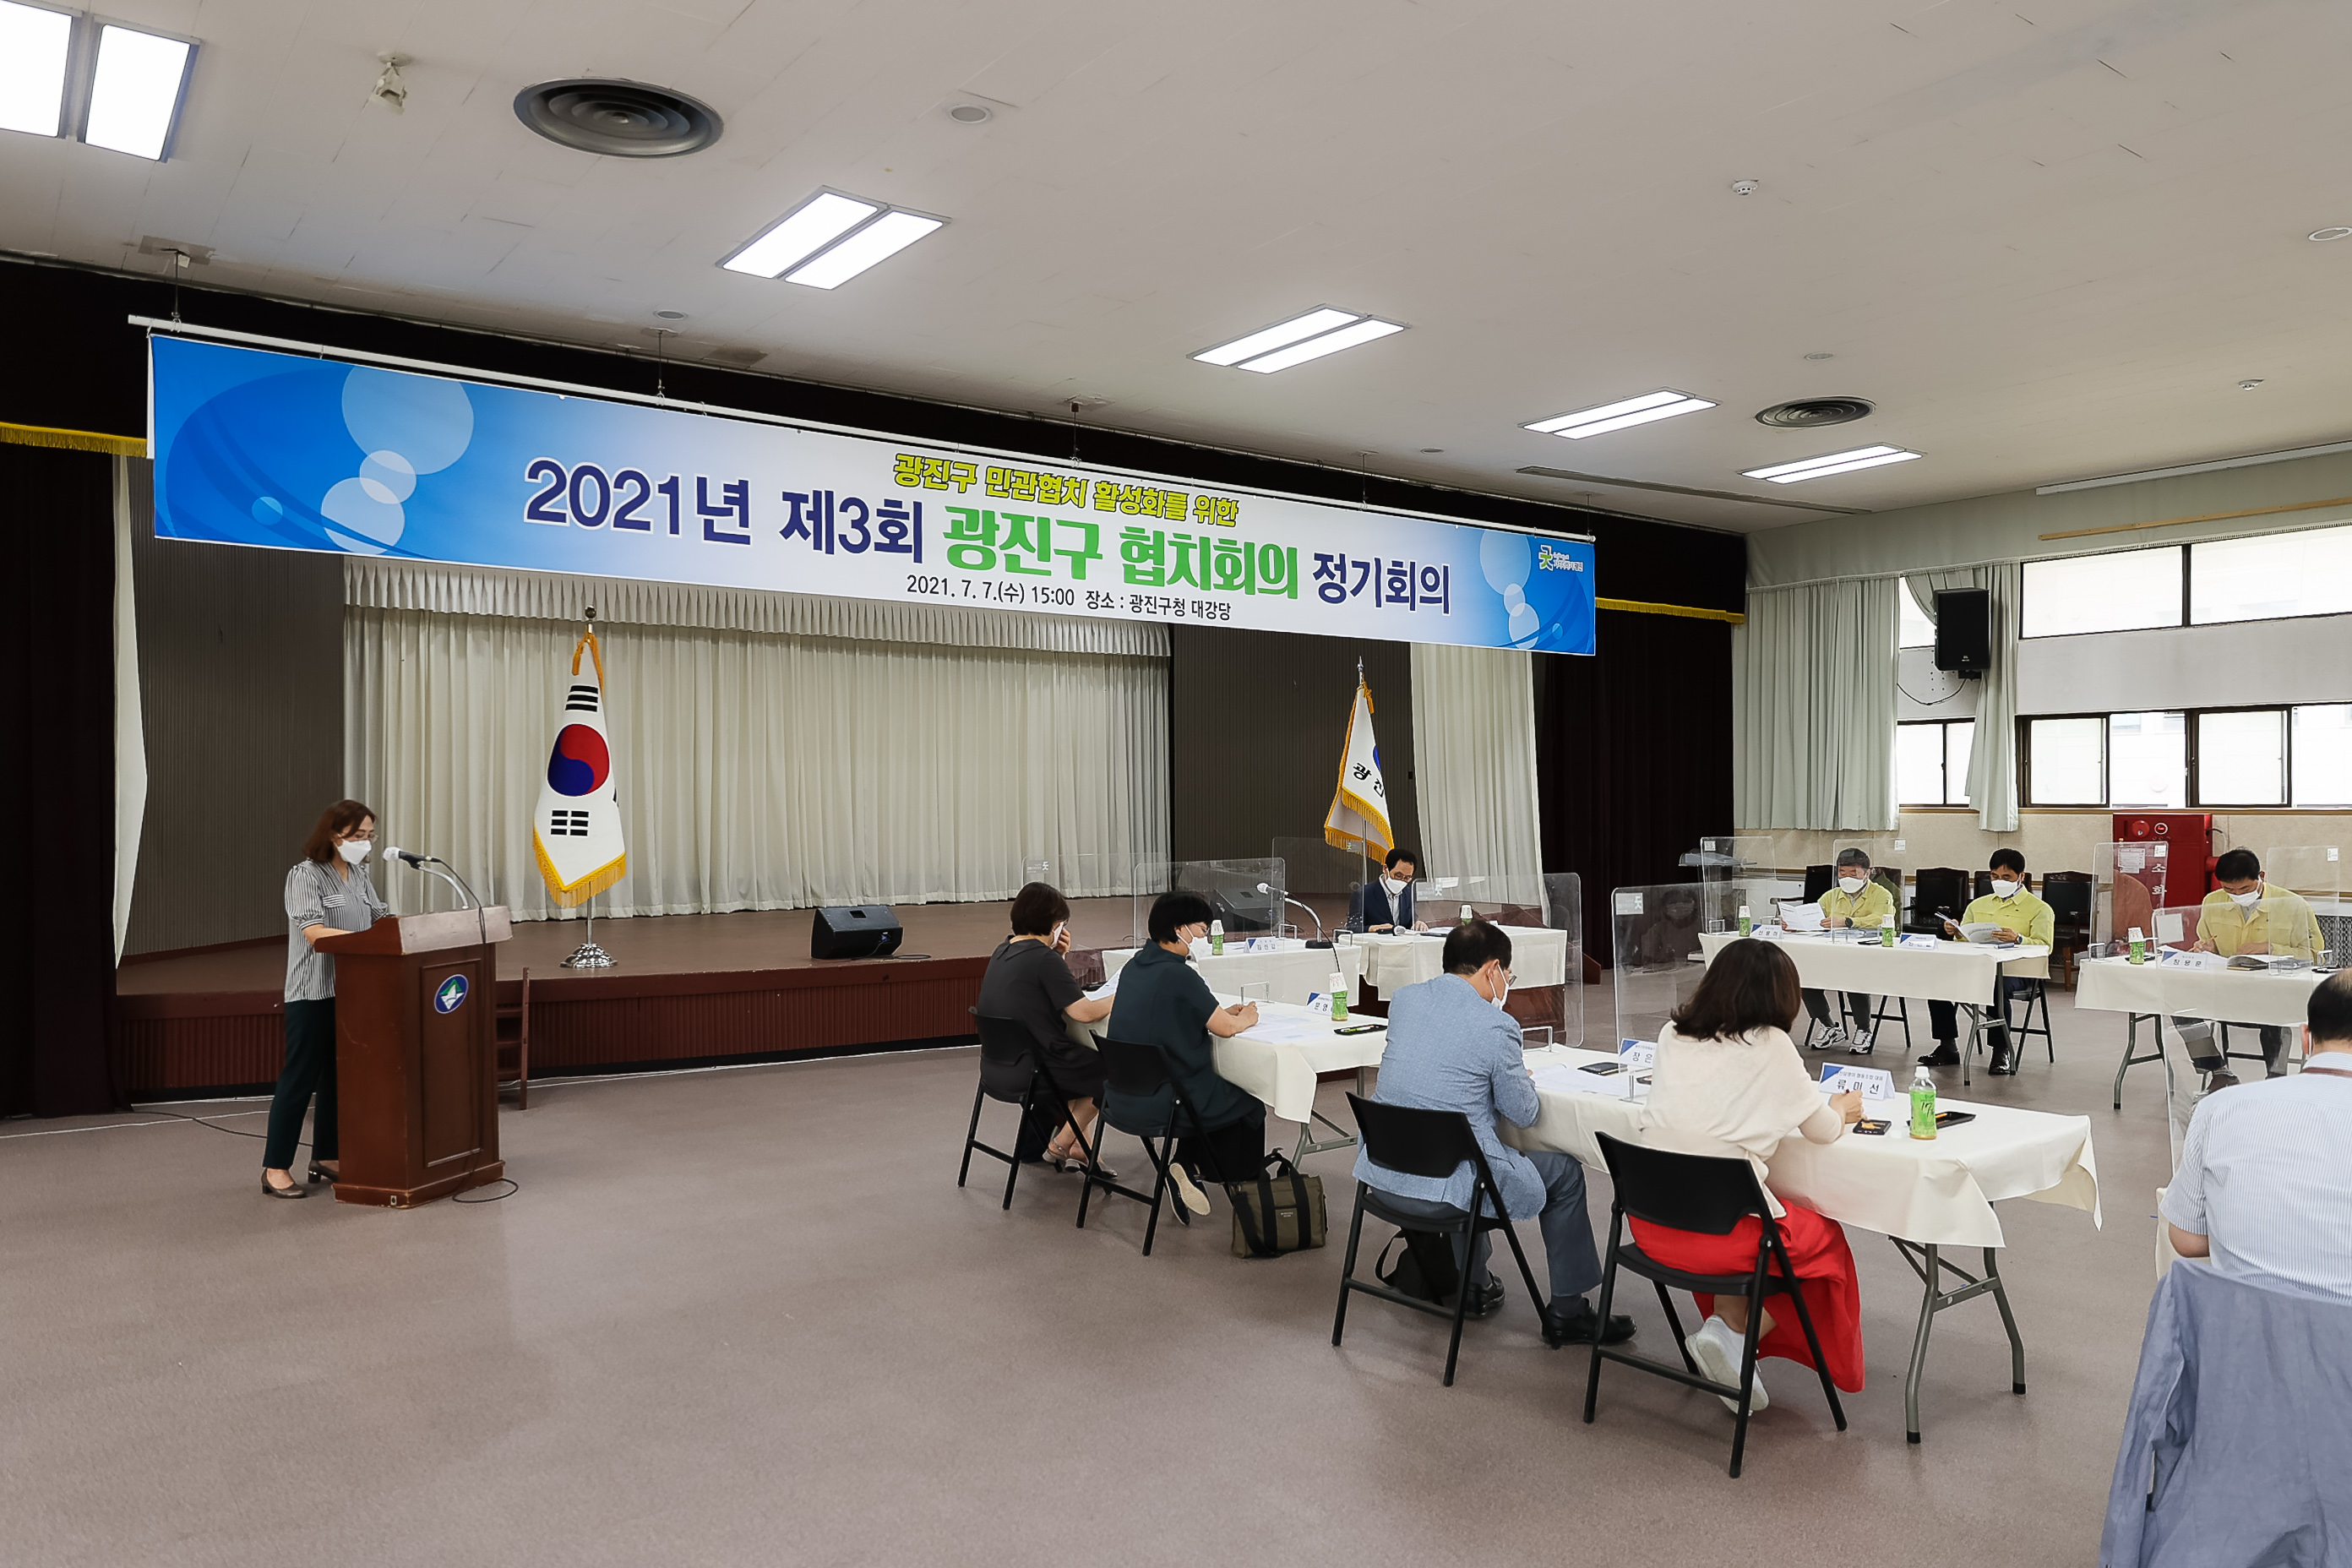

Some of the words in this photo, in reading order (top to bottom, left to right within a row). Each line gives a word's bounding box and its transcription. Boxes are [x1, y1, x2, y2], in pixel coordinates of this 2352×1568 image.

[893, 453, 977, 493] 광진구
[984, 466, 1088, 509] 민관협치
[1093, 480, 1189, 522] 활성화를
[1193, 494, 1239, 527] 위한
[525, 458, 752, 546] 2021년
[778, 488, 924, 564] 제3회
[942, 504, 1103, 580] 광진구
[1119, 525, 1298, 600] 협치회의
[1312, 551, 1450, 615] 정기회의
[906, 574, 956, 597] 2021.
[1031, 585, 1075, 607] 15:00
[1085, 590, 1115, 611] 장소
[1128, 593, 1185, 618] 광진구청
[1190, 597, 1232, 622] 대강당
